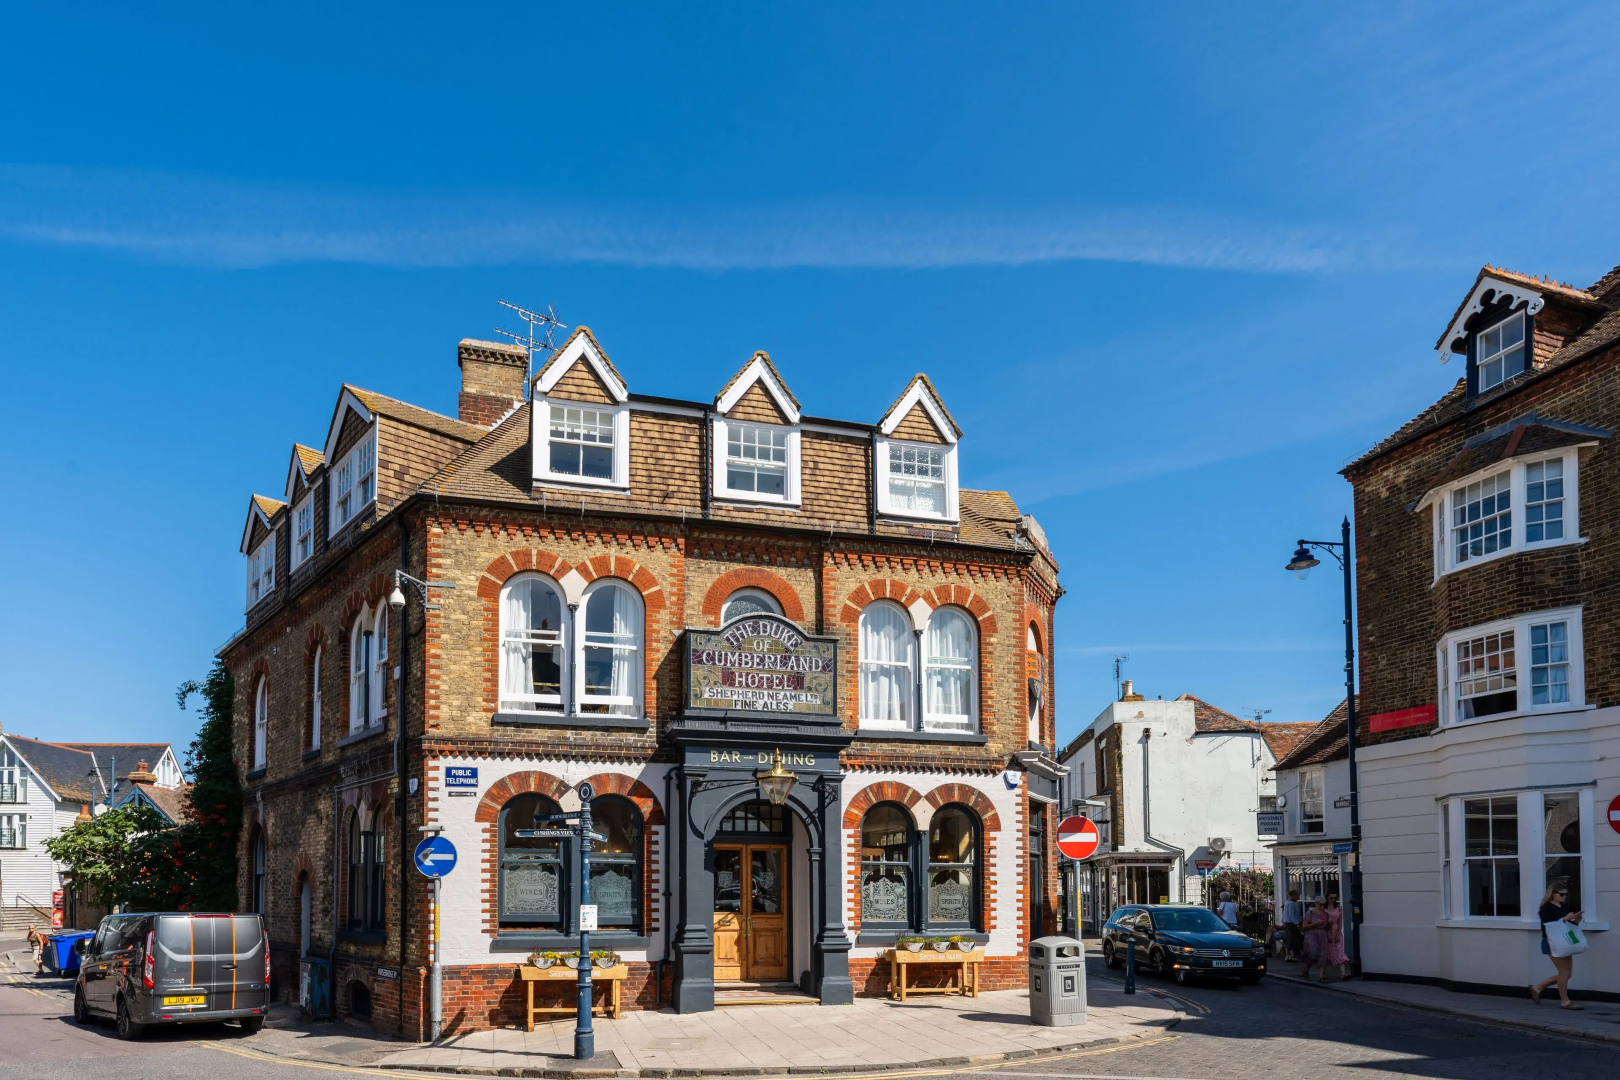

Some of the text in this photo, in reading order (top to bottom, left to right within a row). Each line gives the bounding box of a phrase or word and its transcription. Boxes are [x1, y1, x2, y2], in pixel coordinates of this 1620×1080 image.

[723, 621, 802, 652] THE DUKE
[753, 639, 772, 652] OF
[702, 650, 822, 672] CUMBERLAND
[734, 672, 793, 690] HOTEL
[708, 687, 765, 700] SHEPHERD
[767, 691, 804, 703] NEAME
[734, 700, 758, 709] FINE
[710, 750, 741, 763] BAR
[446, 777, 478, 785] TELEPHONE
[519, 888, 543, 896] WINES
[599, 890, 622, 898] SPIRITS
